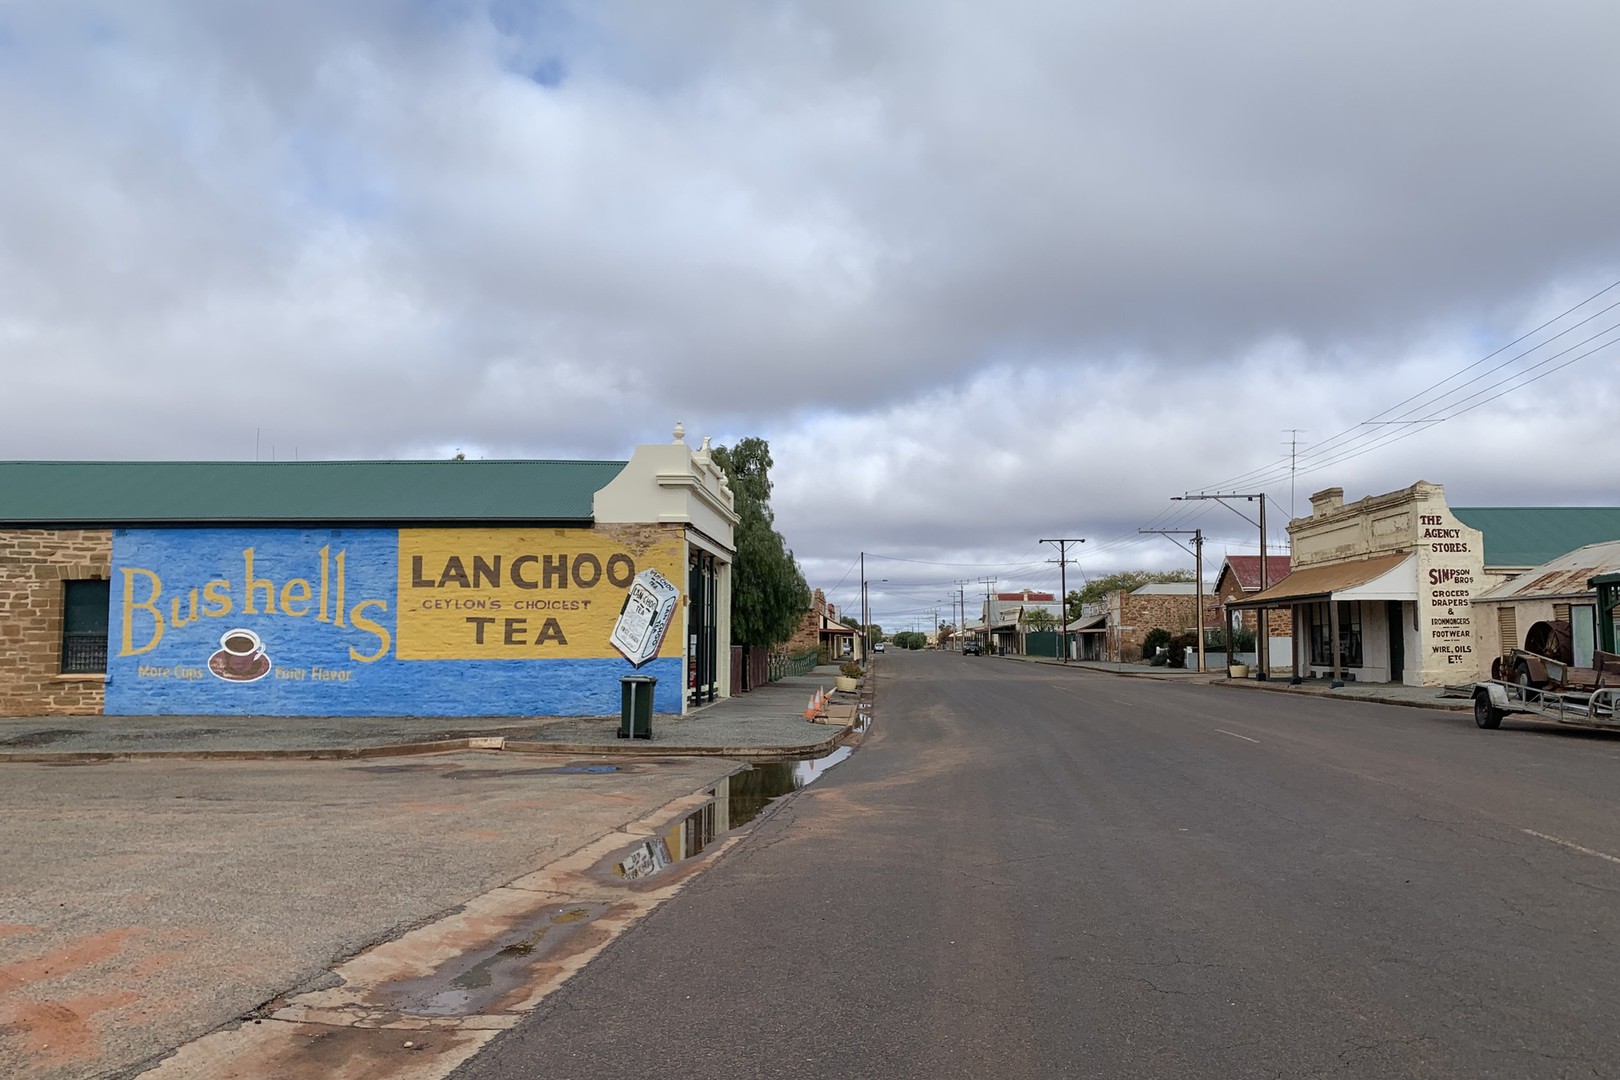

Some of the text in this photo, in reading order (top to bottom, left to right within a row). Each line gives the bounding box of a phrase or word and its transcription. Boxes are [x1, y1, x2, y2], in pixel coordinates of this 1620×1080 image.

[1420, 515, 1443, 525] THE
[1424, 528, 1460, 538] AGENCY
[1432, 543, 1471, 553] STORES.
[1429, 568, 1470, 585] SIMPSON
[117, 544, 391, 662] Bushells
[422, 596, 592, 610] CEYLON'S CHOICEST
[466, 617, 568, 645] TEA
[1454, 645, 1472, 653] OILS
[138, 665, 170, 678] More
[174, 664, 203, 681] Cups
[311, 666, 352, 682] Flavor
